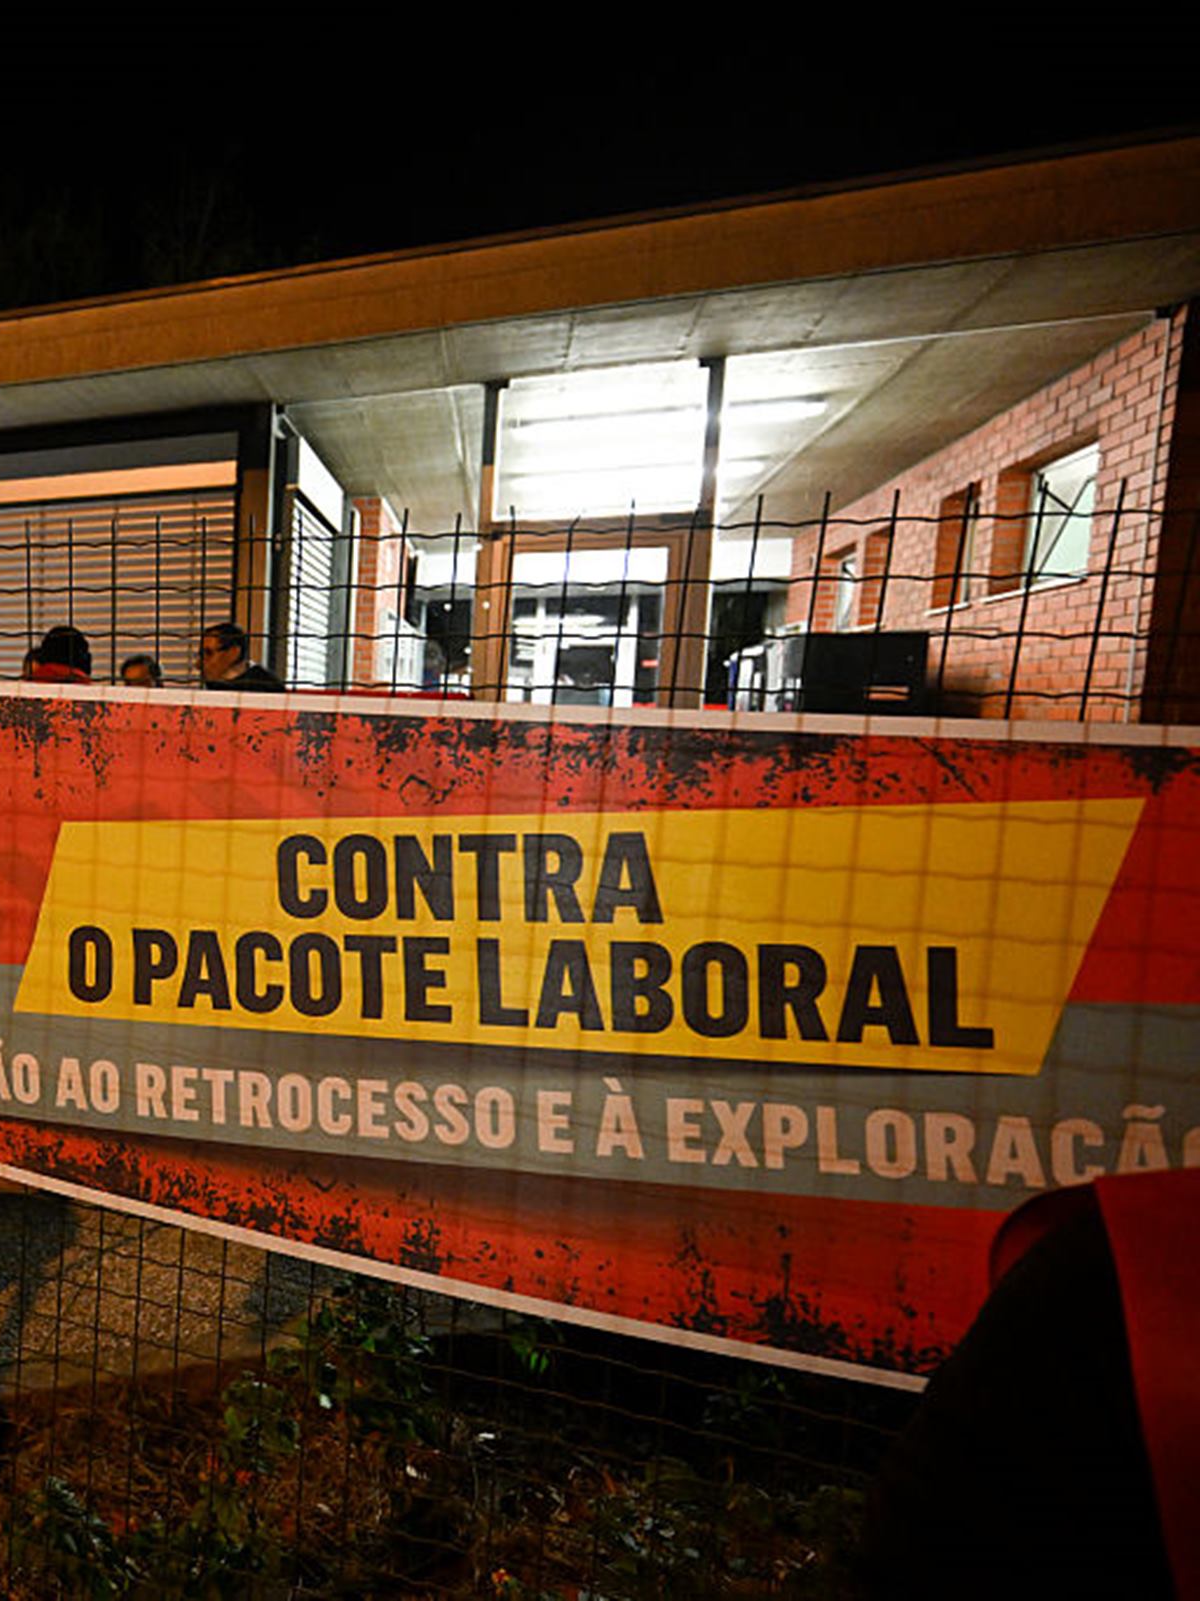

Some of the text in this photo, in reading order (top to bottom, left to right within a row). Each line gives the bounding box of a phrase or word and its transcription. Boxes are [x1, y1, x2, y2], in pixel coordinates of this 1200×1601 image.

[277, 831, 664, 924] CONTRA
[67, 925, 995, 1050] O PACOTE LABORAL
[56, 1057, 120, 1114] AO
[135, 1063, 517, 1150] RETROCESSO
[536, 1089, 575, 1154] E
[596, 1077, 645, 1161] À
